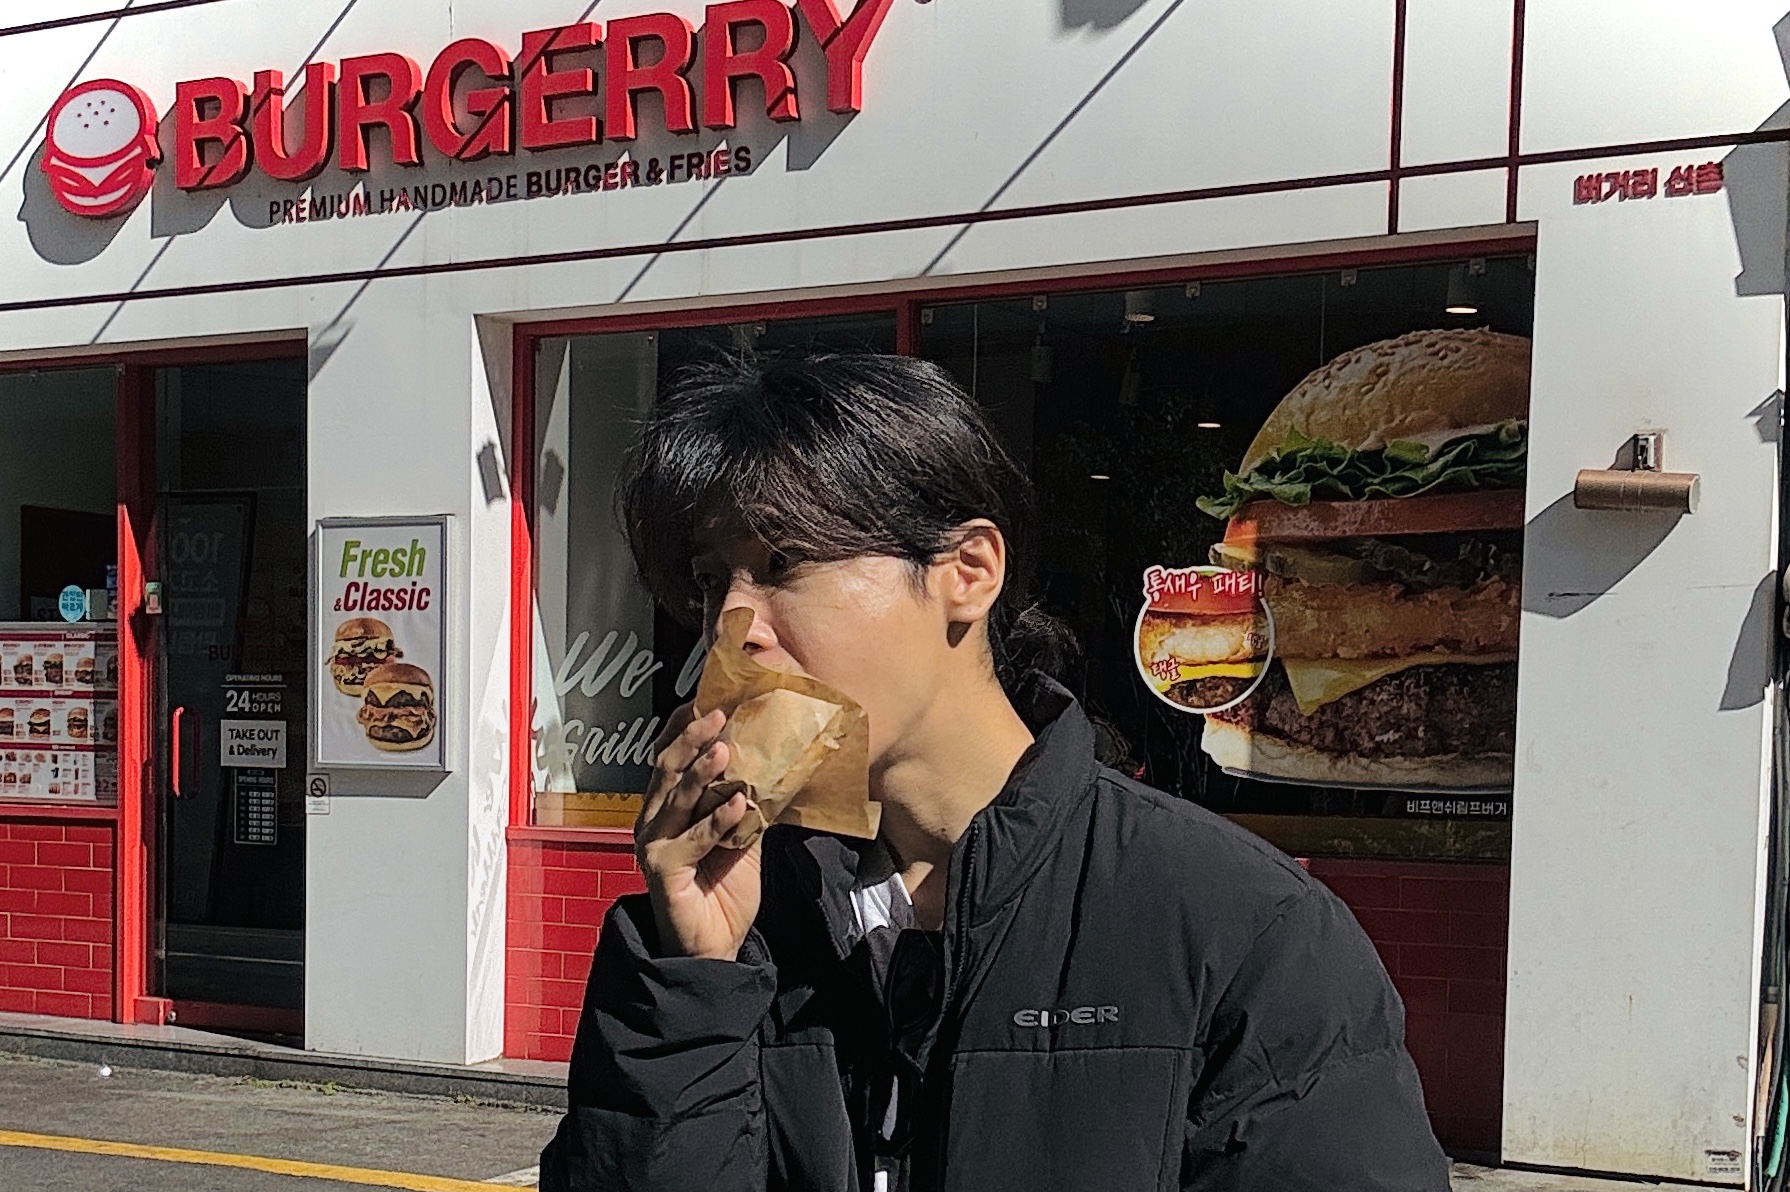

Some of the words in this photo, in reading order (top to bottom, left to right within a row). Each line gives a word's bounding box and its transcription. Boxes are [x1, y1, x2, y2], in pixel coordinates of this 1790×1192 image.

[174, 0, 893, 191] BURGERRY
[269, 191, 371, 225] PREMIUM
[380, 175, 518, 214] HANDMADE
[526, 160, 640, 197] BURGER
[646, 157, 666, 186] &
[670, 146, 752, 182] FRIES
[1573, 167, 1659, 205] 버거리
[339, 539, 426, 578] Fresh
[1147, 569, 1202, 602] 통새우
[1211, 571, 1263, 597] 패티!
[555, 631, 664, 698] We
[225, 689, 251, 712] 24
[252, 692, 281, 702] HOURS
[252, 702, 281, 713] OPEN
[228, 728, 256, 741] TAKE
[257, 728, 281, 742] OUT
[237, 743, 278, 760] Delivery
[1406, 799, 1507, 816] 비프앤쉬림프버거
[1013, 1005, 1119, 1028] EIDER
